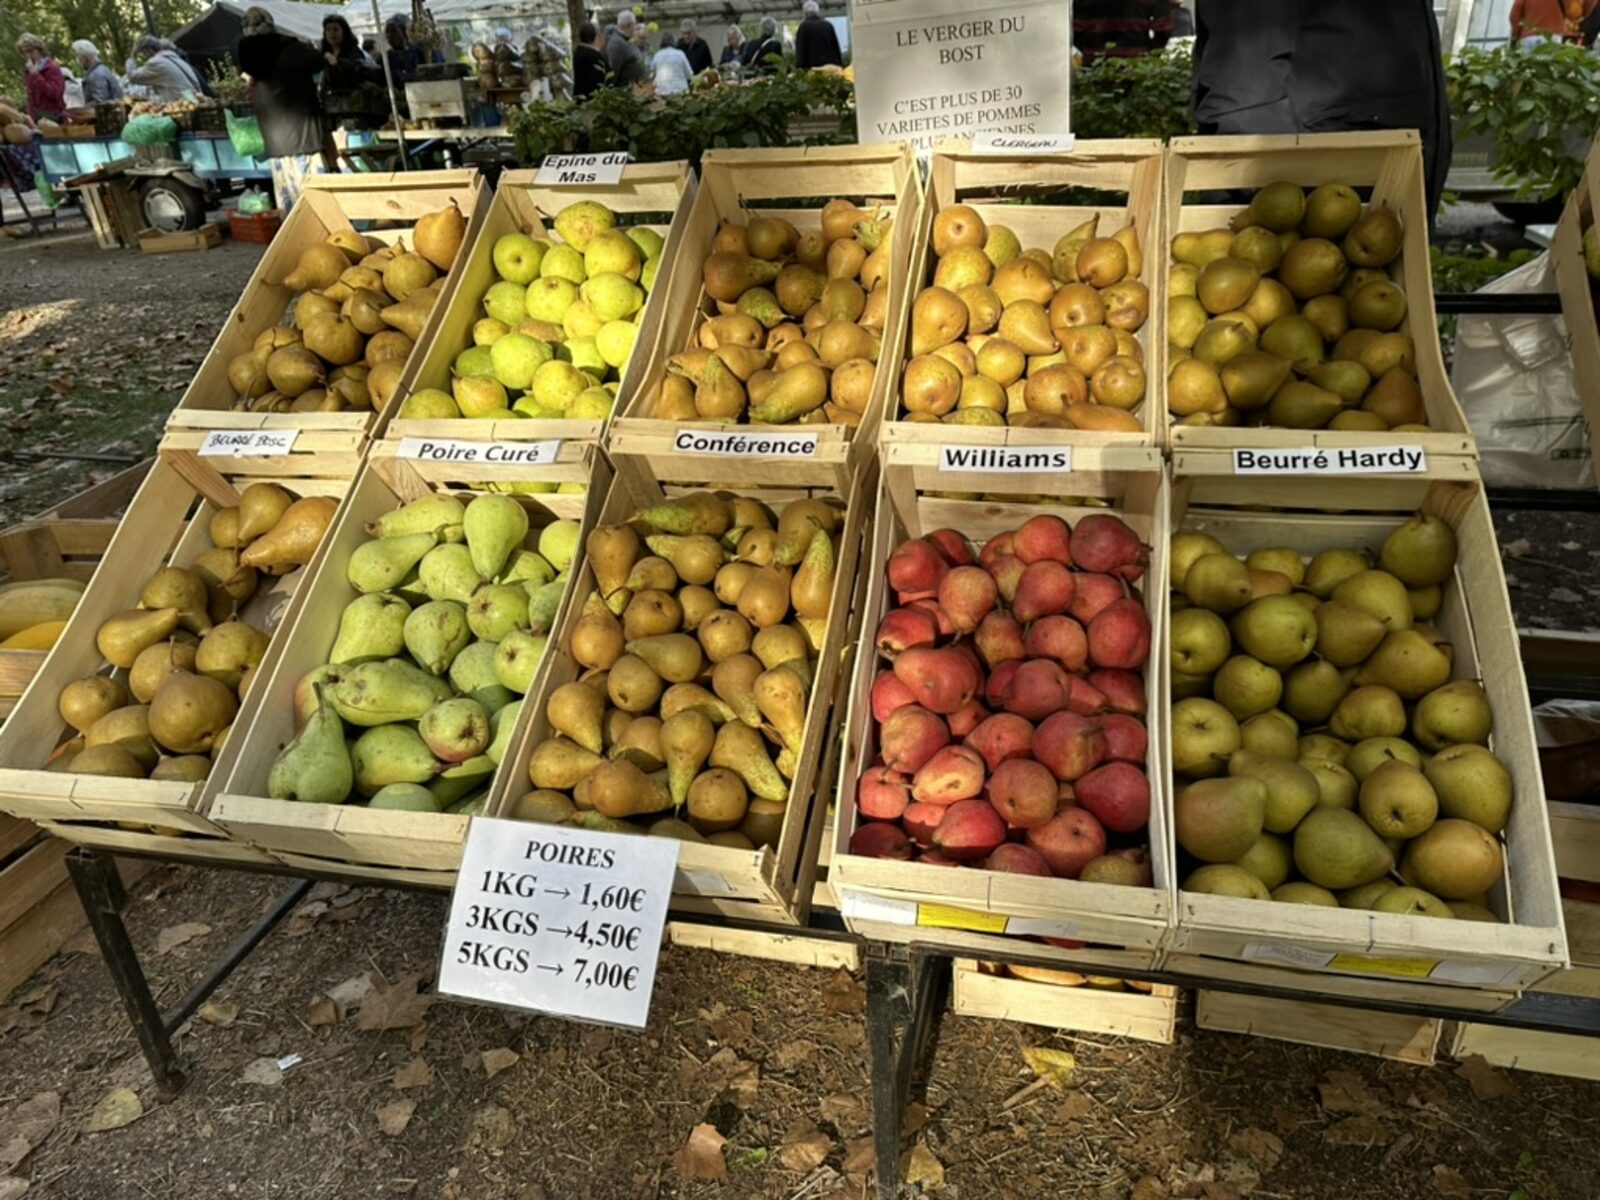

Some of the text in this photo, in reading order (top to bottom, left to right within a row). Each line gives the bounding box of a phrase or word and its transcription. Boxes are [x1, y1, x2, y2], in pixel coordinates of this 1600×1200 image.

[896, 15, 1025, 47] LE VERGER DU
[939, 44, 985, 65] BOST
[894, 85, 1023, 115] C'EST PLUS DE 30
[877, 103, 1042, 136] VARIETES DE POMMES
[544, 153, 626, 170] Epine du
[558, 171, 597, 183] Mas
[418, 443, 539, 462] Poire Curé
[676, 433, 815, 454] Conférence
[946, 449, 1066, 468] Williams
[1237, 448, 1422, 470] Beurré Hardy
[525, 840, 616, 870] POIRES
[480, 870, 647, 912] 1KG 1,60€
[465, 905, 642, 951] 3KGS 4,50€
[457, 941, 640, 991] 5KGS 7,00€
